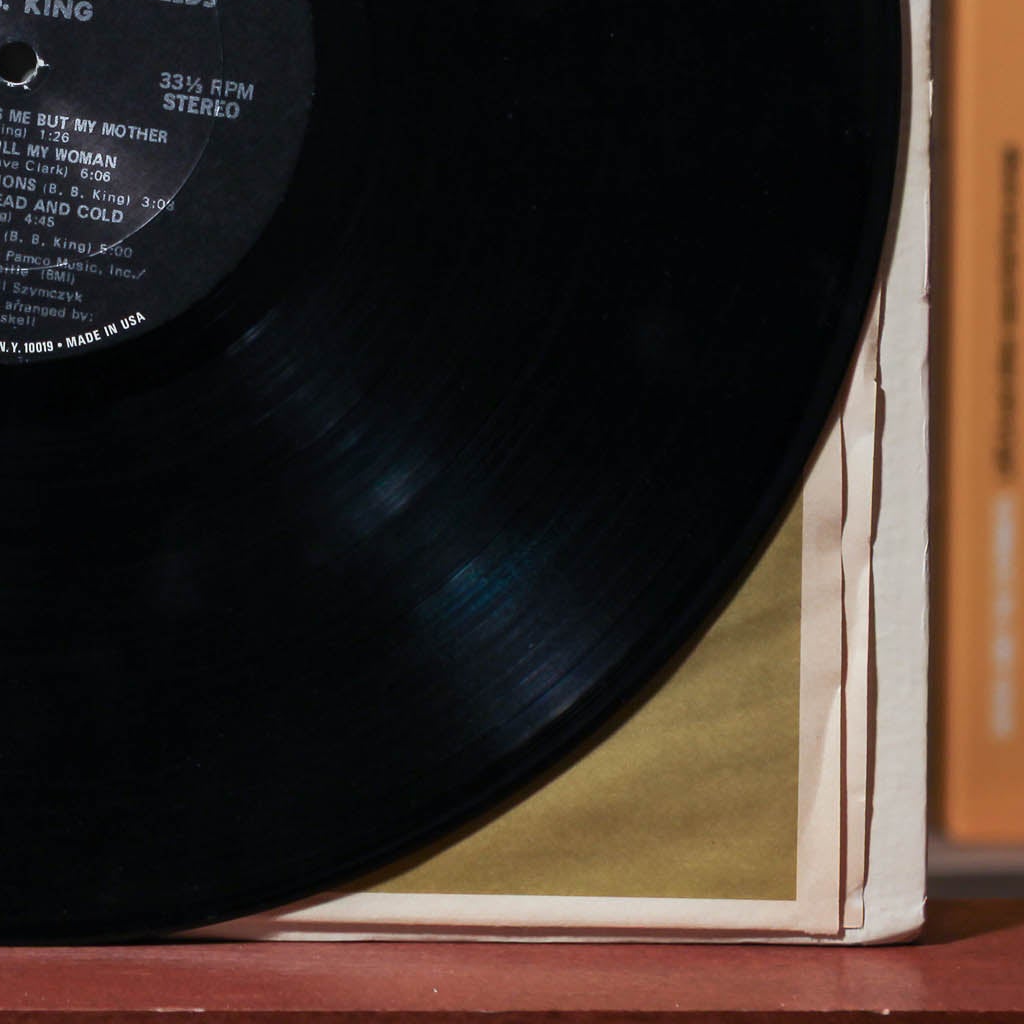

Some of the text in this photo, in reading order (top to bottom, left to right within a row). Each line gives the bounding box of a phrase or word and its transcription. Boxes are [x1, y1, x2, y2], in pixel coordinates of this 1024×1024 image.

[210, 78, 254, 101] RPM
[162, 93, 240, 119] STEREO
[8, 109, 32, 124] ME
[36, 113, 69, 130] BUT
[74, 118, 96, 134] MY
[102, 122, 168, 144] MOTHER
[40, 130, 70, 143] 1:26
[27, 144, 49, 159] MY
[56, 147, 118, 168] WOMAN
[26, 160, 68, 178] Clark)
[80, 168, 112, 182] 6:06
[43, 183, 63, 196] (B.
[70, 186, 84, 198] B.
[92, 189, 130, 206] King)
[24, 214, 55, 228] 4:45
[33, 199, 70, 216] AND
[77, 205, 124, 224] COLD
[4, 230, 23, 243] (B.
[32, 234, 45, 246] B.
[54, 236, 92, 254] King)
[6, 250, 51, 266] Pamco
[56, 258, 102, 275] Music,
[41, 268, 76, 285] (BMI)
[12, 282, 84, 303] Szymczyk
[6, 300, 66, 318] arranged
[72, 308, 94, 322] by:
[24, 341, 54, 354] 10019
[66, 330, 102, 348] MADE
[104, 324, 118, 337] IN
[120, 312, 146, 330] USA
